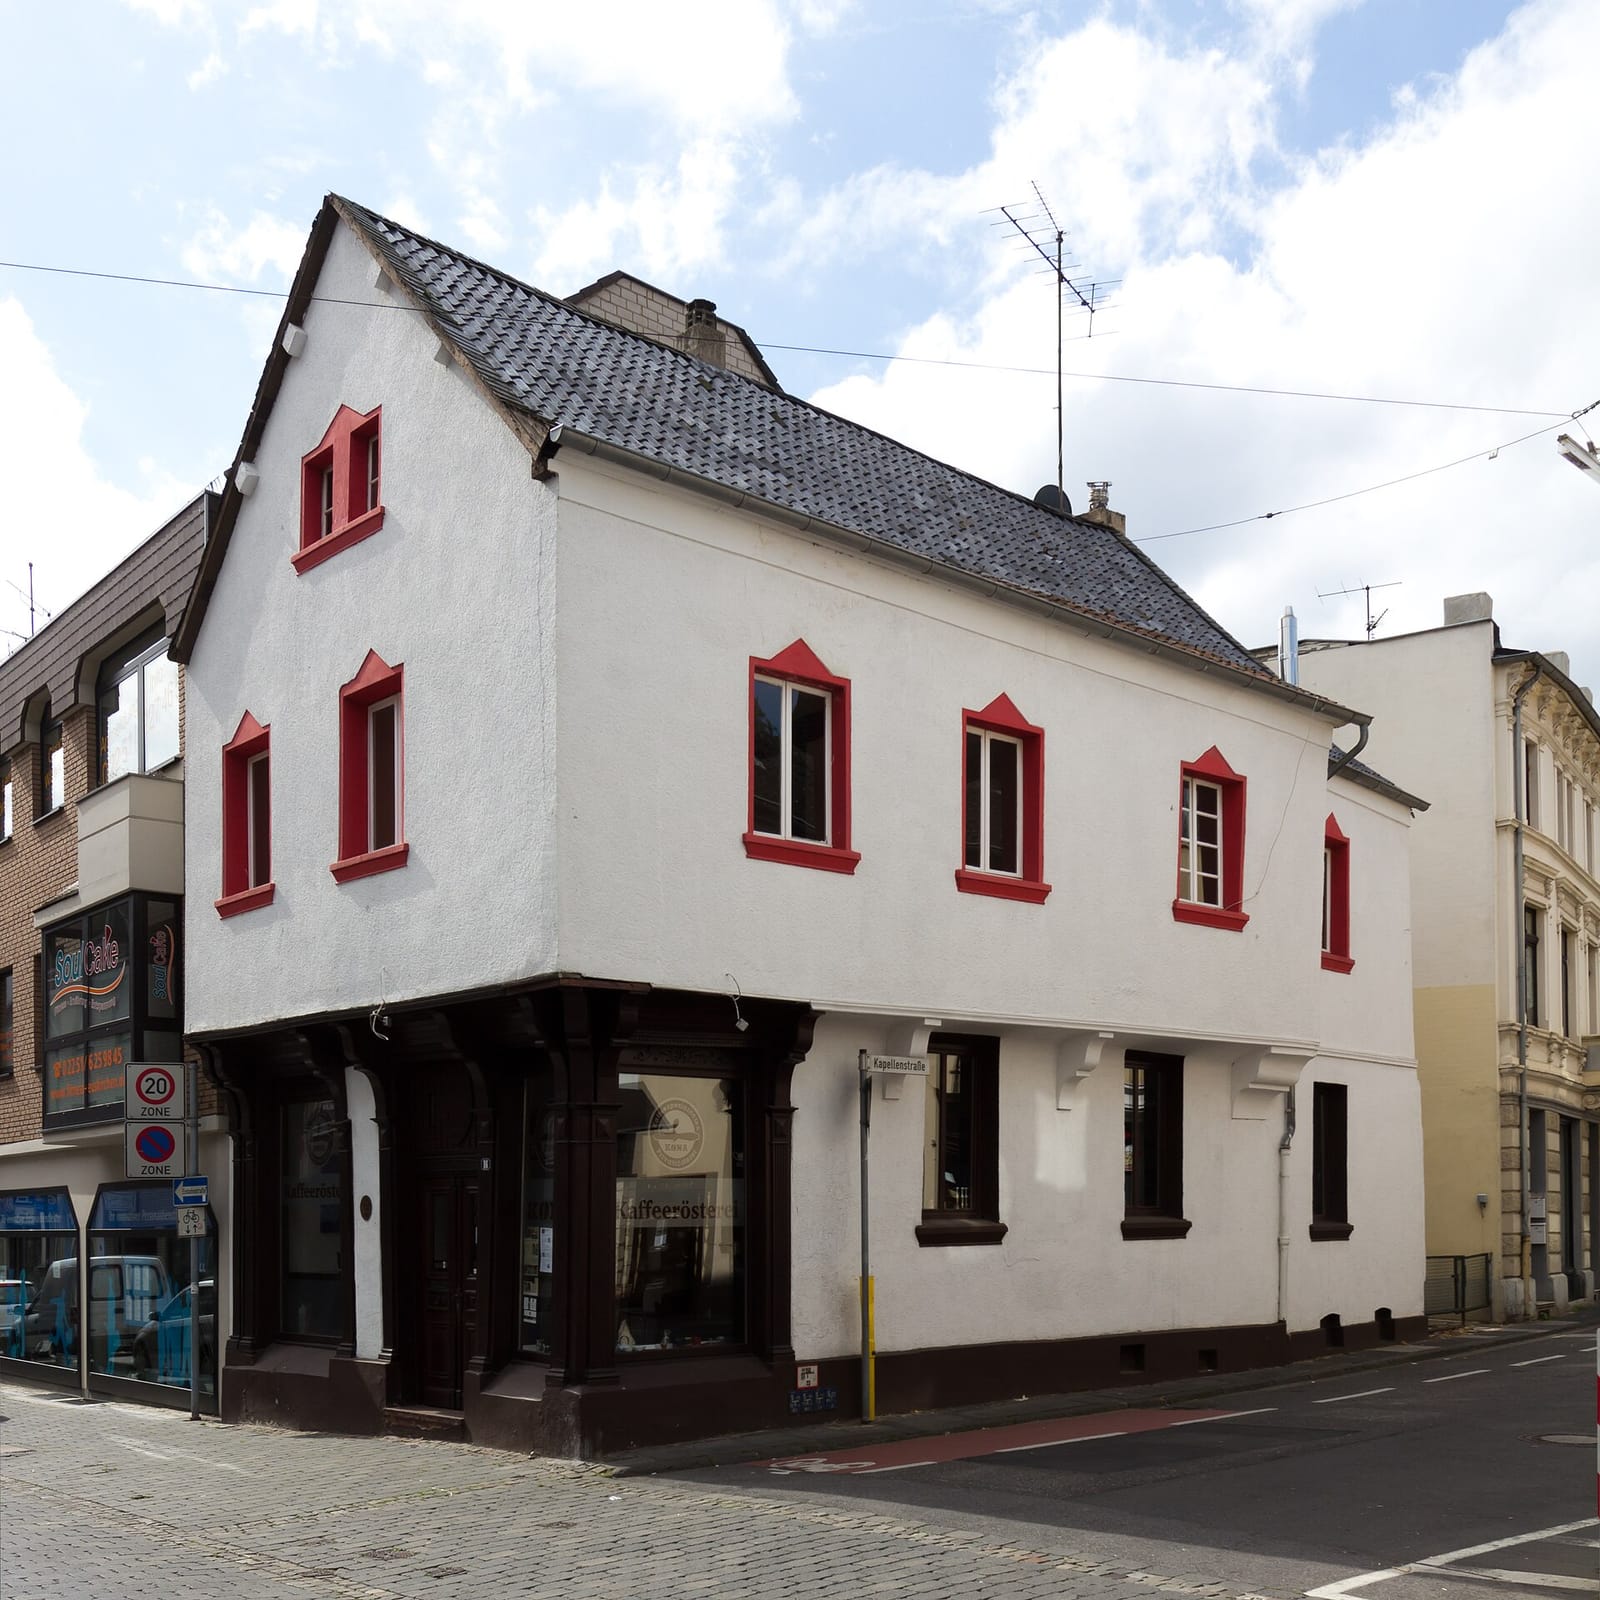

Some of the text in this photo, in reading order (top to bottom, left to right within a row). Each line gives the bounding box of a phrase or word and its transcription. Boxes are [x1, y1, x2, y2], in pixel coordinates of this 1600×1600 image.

[84, 924, 119, 976] Cake
[873, 1057, 926, 1071] Kapellenstraße
[145, 1077, 167, 1094] 20
[141, 1107, 171, 1117] ZONE
[141, 1165, 171, 1175] ZONE
